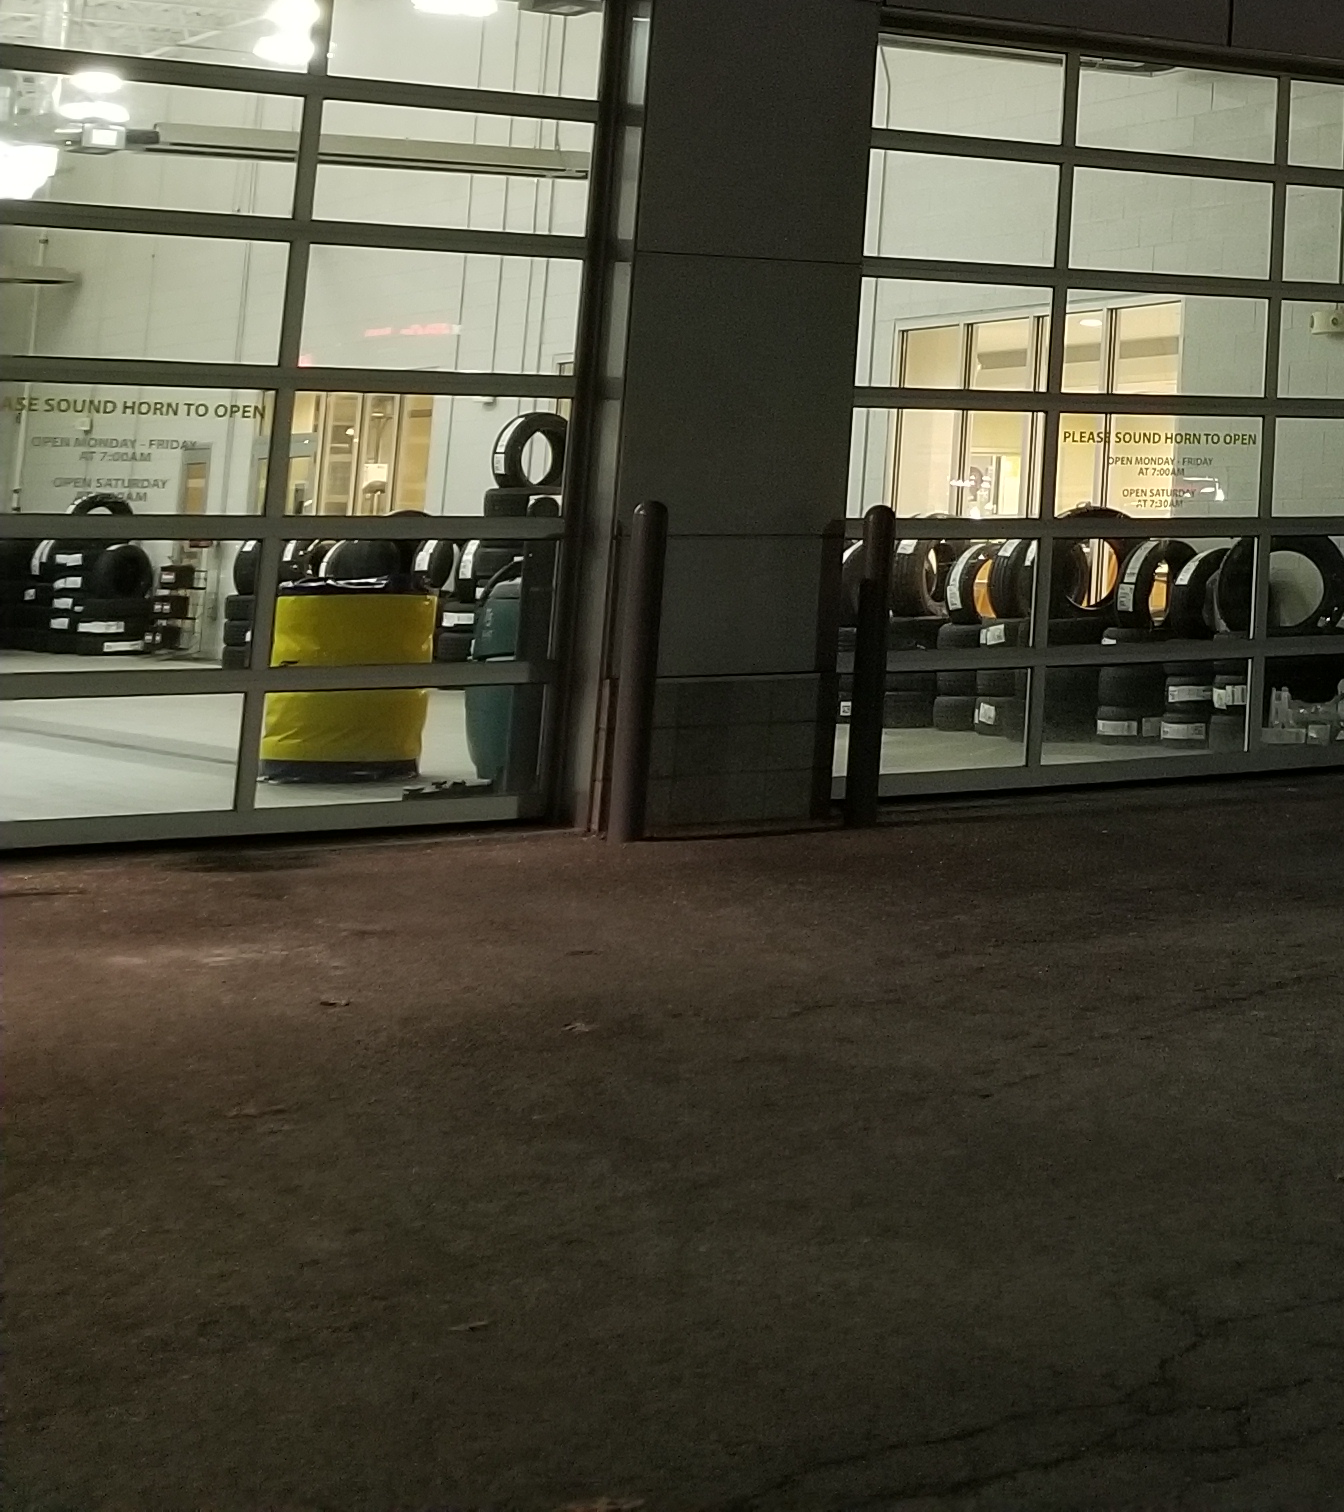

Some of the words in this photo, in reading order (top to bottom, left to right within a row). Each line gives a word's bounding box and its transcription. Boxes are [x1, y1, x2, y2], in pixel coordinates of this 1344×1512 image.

[43, 397, 118, 415] SOUND
[121, 400, 179, 417] HORN
[183, 402, 209, 418] TO
[213, 403, 267, 420] OPEN
[31, 437, 70, 448] OPEN
[73, 438, 137, 449] MONDAY
[148, 439, 198, 450] FRIDAY
[1063, 431, 1111, 444] PLEASE
[1114, 431, 1161, 445] SOUND
[1164, 432, 1201, 445] HORN
[1203, 433, 1220, 445] TO
[1223, 433, 1257, 446] OPEN
[79, 451, 97, 461] AT
[99, 451, 152, 462] 7:00AM
[1108, 457, 1133, 466] OPEN
[1135, 457, 1175, 466] MONDAY
[1182, 457, 1213, 466] FRIDAY
[1138, 468, 1150, 476] AT
[1151, 468, 1185, 476] 7:00AM
[53, 477, 92, 489] OPEN
[96, 478, 168, 489] SATURDAY
[1122, 488, 1147, 497] OPEN
[1149, 489, 1197, 498] SATURDAY
[1136, 499, 1149, 508] AT
[1150, 499, 1184, 508] 7:30AM
